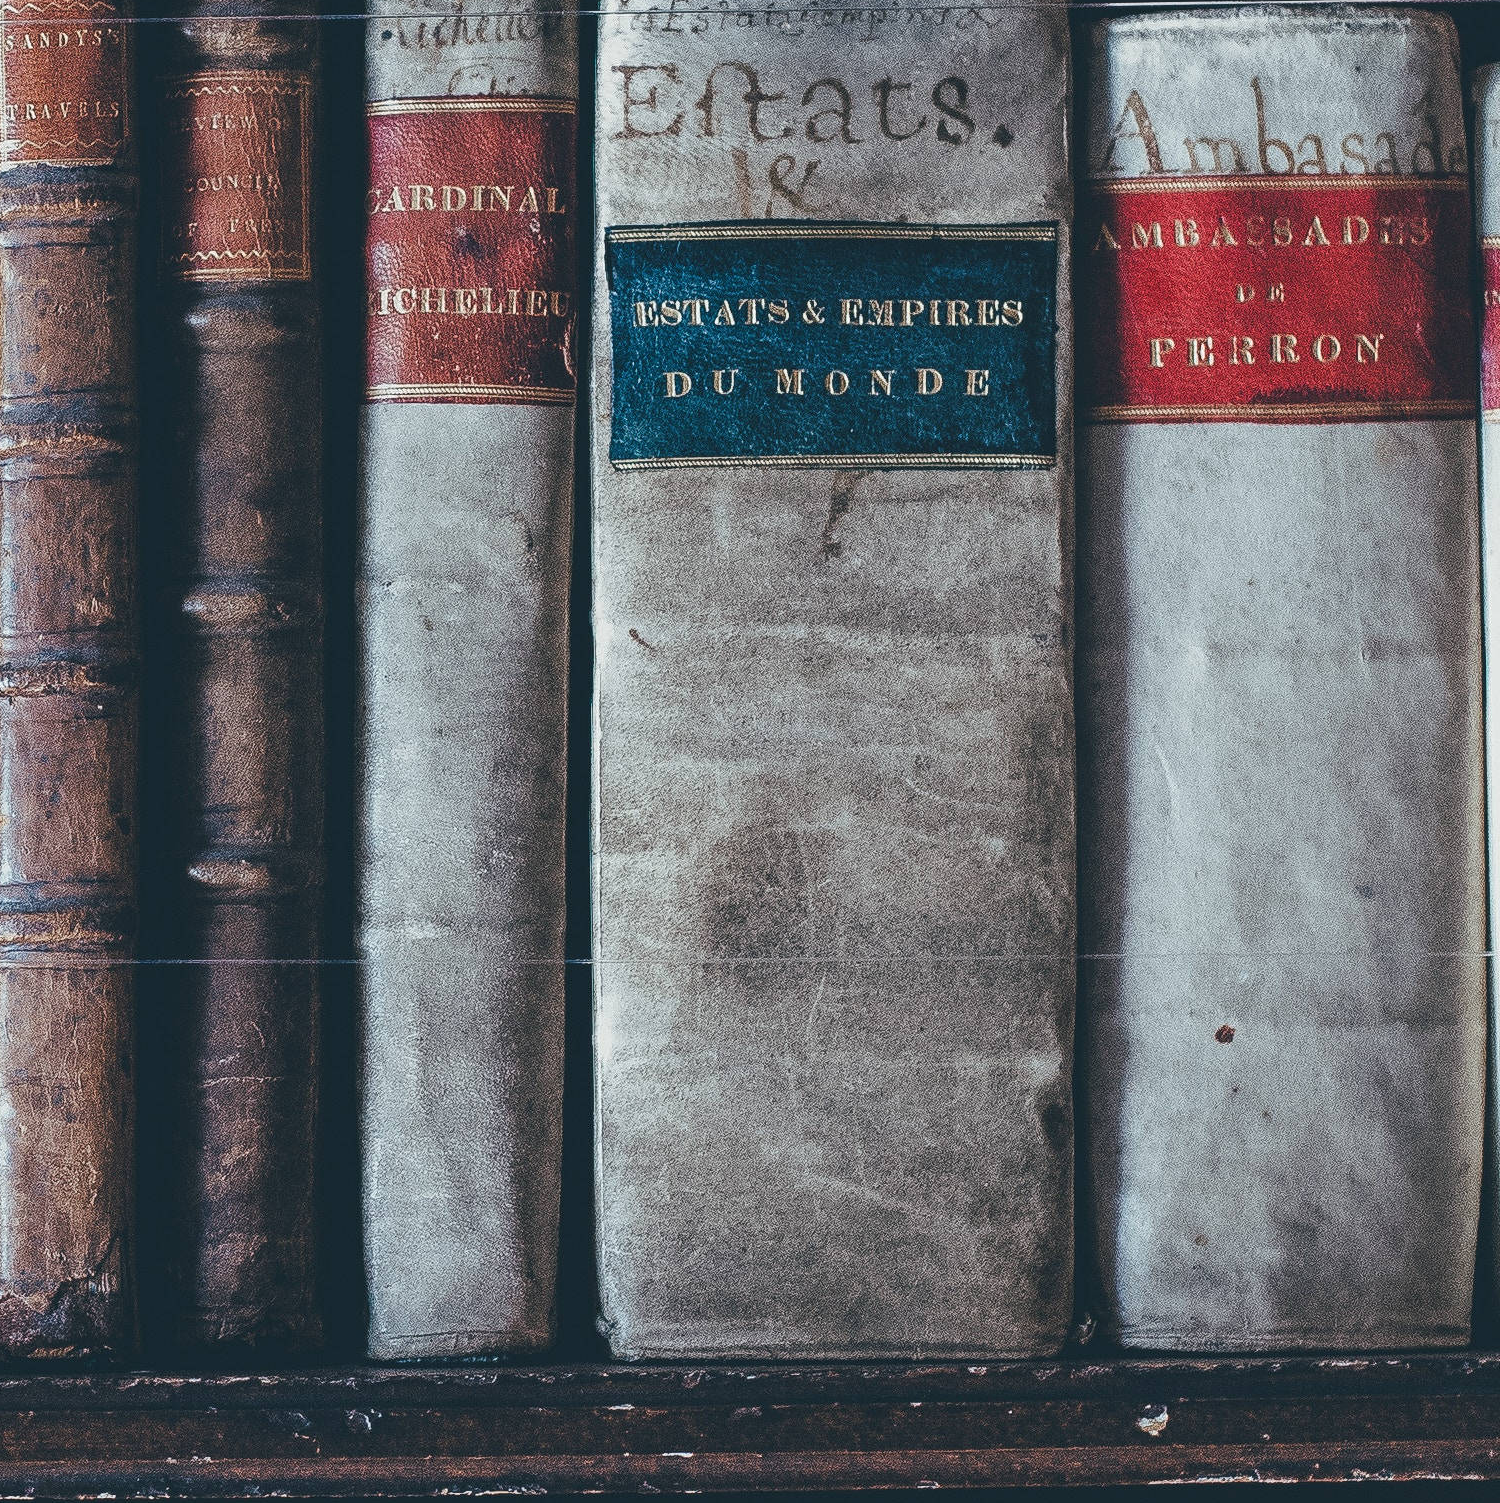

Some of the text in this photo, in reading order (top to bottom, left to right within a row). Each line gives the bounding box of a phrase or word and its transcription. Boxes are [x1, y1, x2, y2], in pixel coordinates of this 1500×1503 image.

[4, 26, 120, 50] SANDYS'S
[5, 100, 120, 122] TRAVELS
[1094, 215, 1432, 250] AMBASSADES
[1235, 282, 1286, 304] DE
[633, 297, 1026, 329] ESTATS & EMPIRES
[1148, 333, 1384, 368] PERRON
[663, 367, 991, 398] DU MONDE
